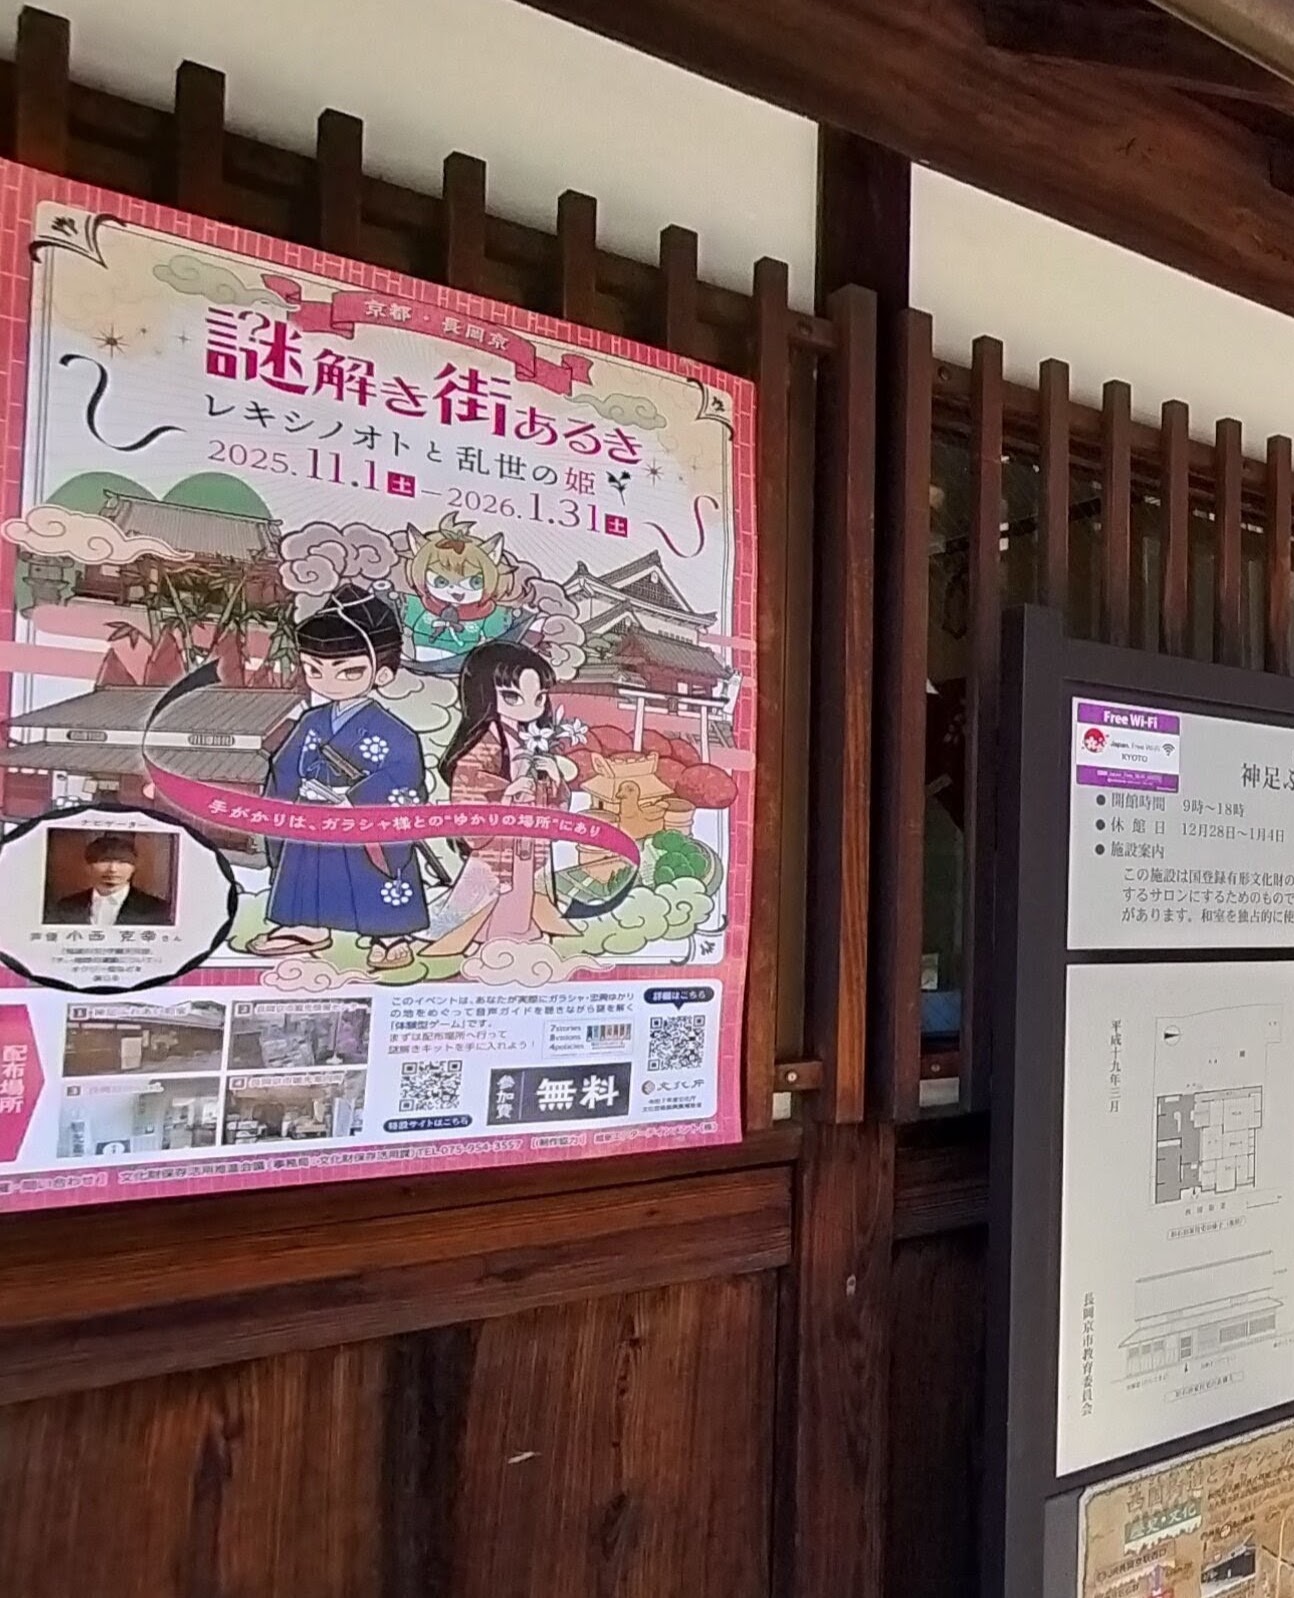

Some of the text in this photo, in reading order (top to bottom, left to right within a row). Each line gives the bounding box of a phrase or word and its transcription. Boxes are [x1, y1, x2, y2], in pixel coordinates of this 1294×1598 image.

[364, 299, 509, 350] 京都・長岡京
[206, 307, 643, 465] 謎解き街あるき
[205, 394, 596, 496] レキシノオトと乱世の姫
[1103, 710, 1158, 729] Free Wi-Fi
[1121, 753, 1149, 763] KYOTO
[1111, 793, 1165, 812] 開館時間
[1110, 841, 1164, 859] 施設案内
[0, 1045, 28, 1114] 配布場所
[1109, 1018, 1122, 1113] 平成十九年三月
[536, 1074, 619, 1111] 無料
[1081, 1292, 1095, 1416] 長岡京市教育委員会
